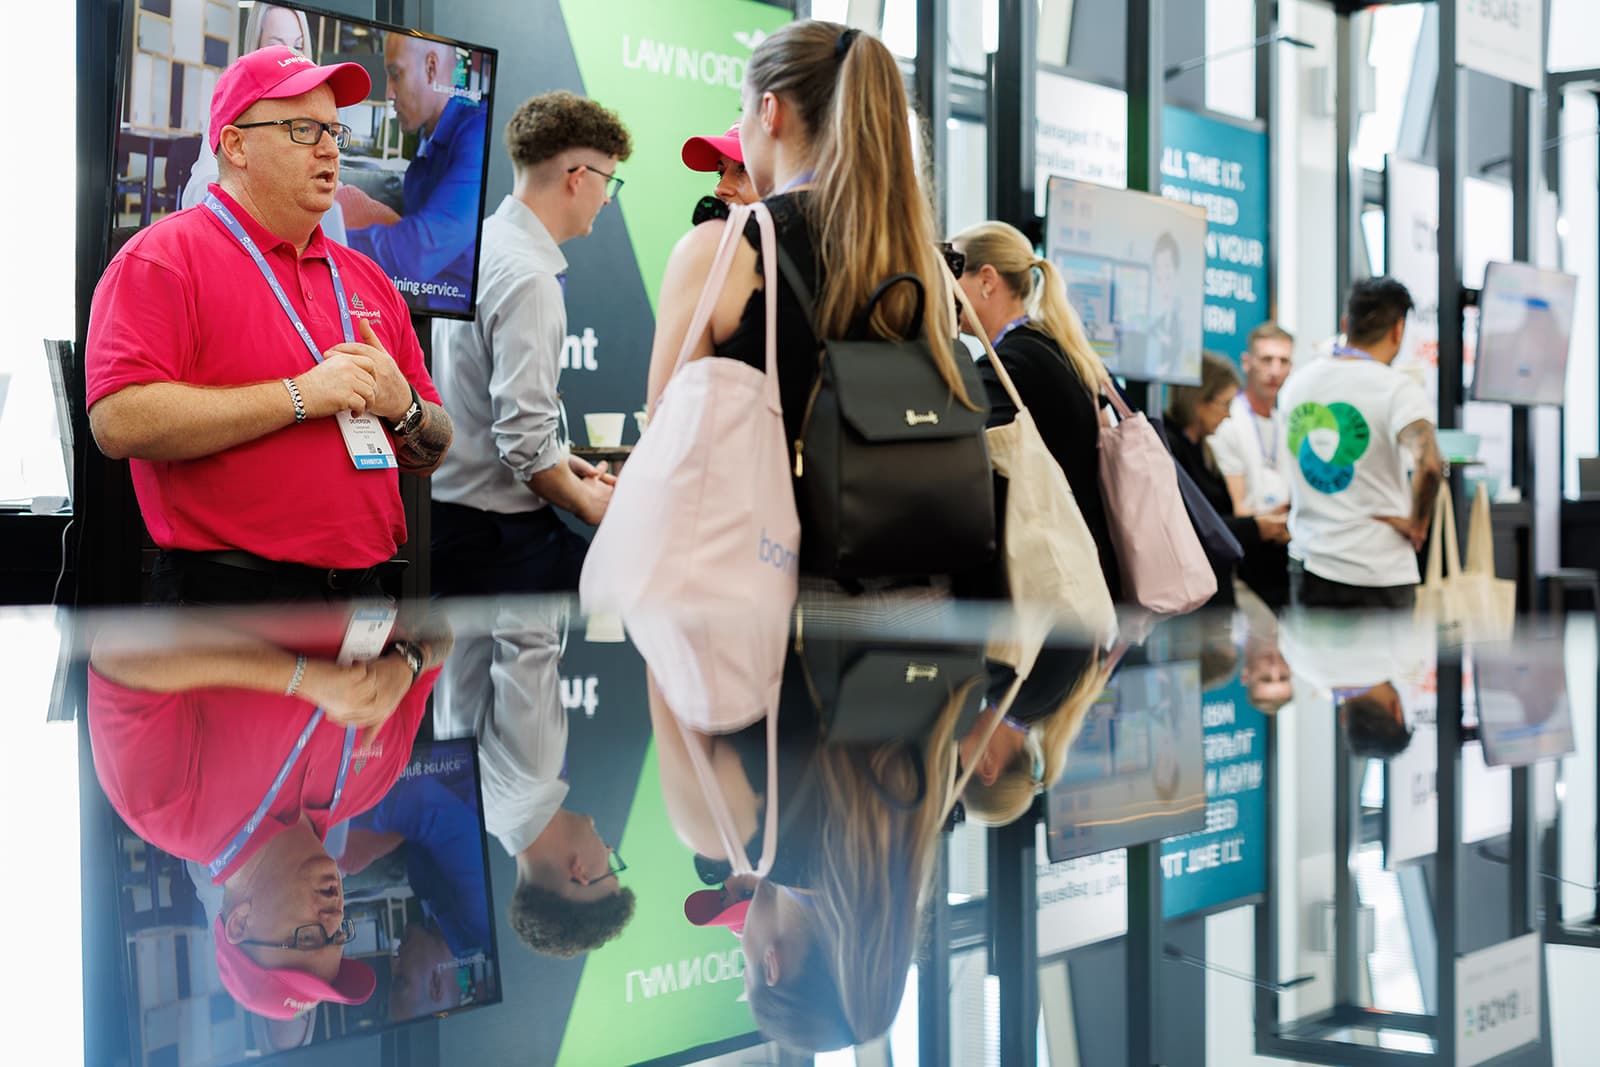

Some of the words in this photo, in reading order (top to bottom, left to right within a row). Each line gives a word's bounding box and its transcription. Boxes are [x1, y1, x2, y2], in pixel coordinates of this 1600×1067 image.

[622, 33, 675, 76] LAW
[675, 46, 699, 81] IN
[700, 51, 746, 90] ORD
[1186, 152, 1221, 186] THE
[1218, 233, 1264, 268] YOUR
[1205, 268, 1256, 302] SSFUL
[1204, 304, 1237, 334] IRM
[560, 327, 599, 371] nt
